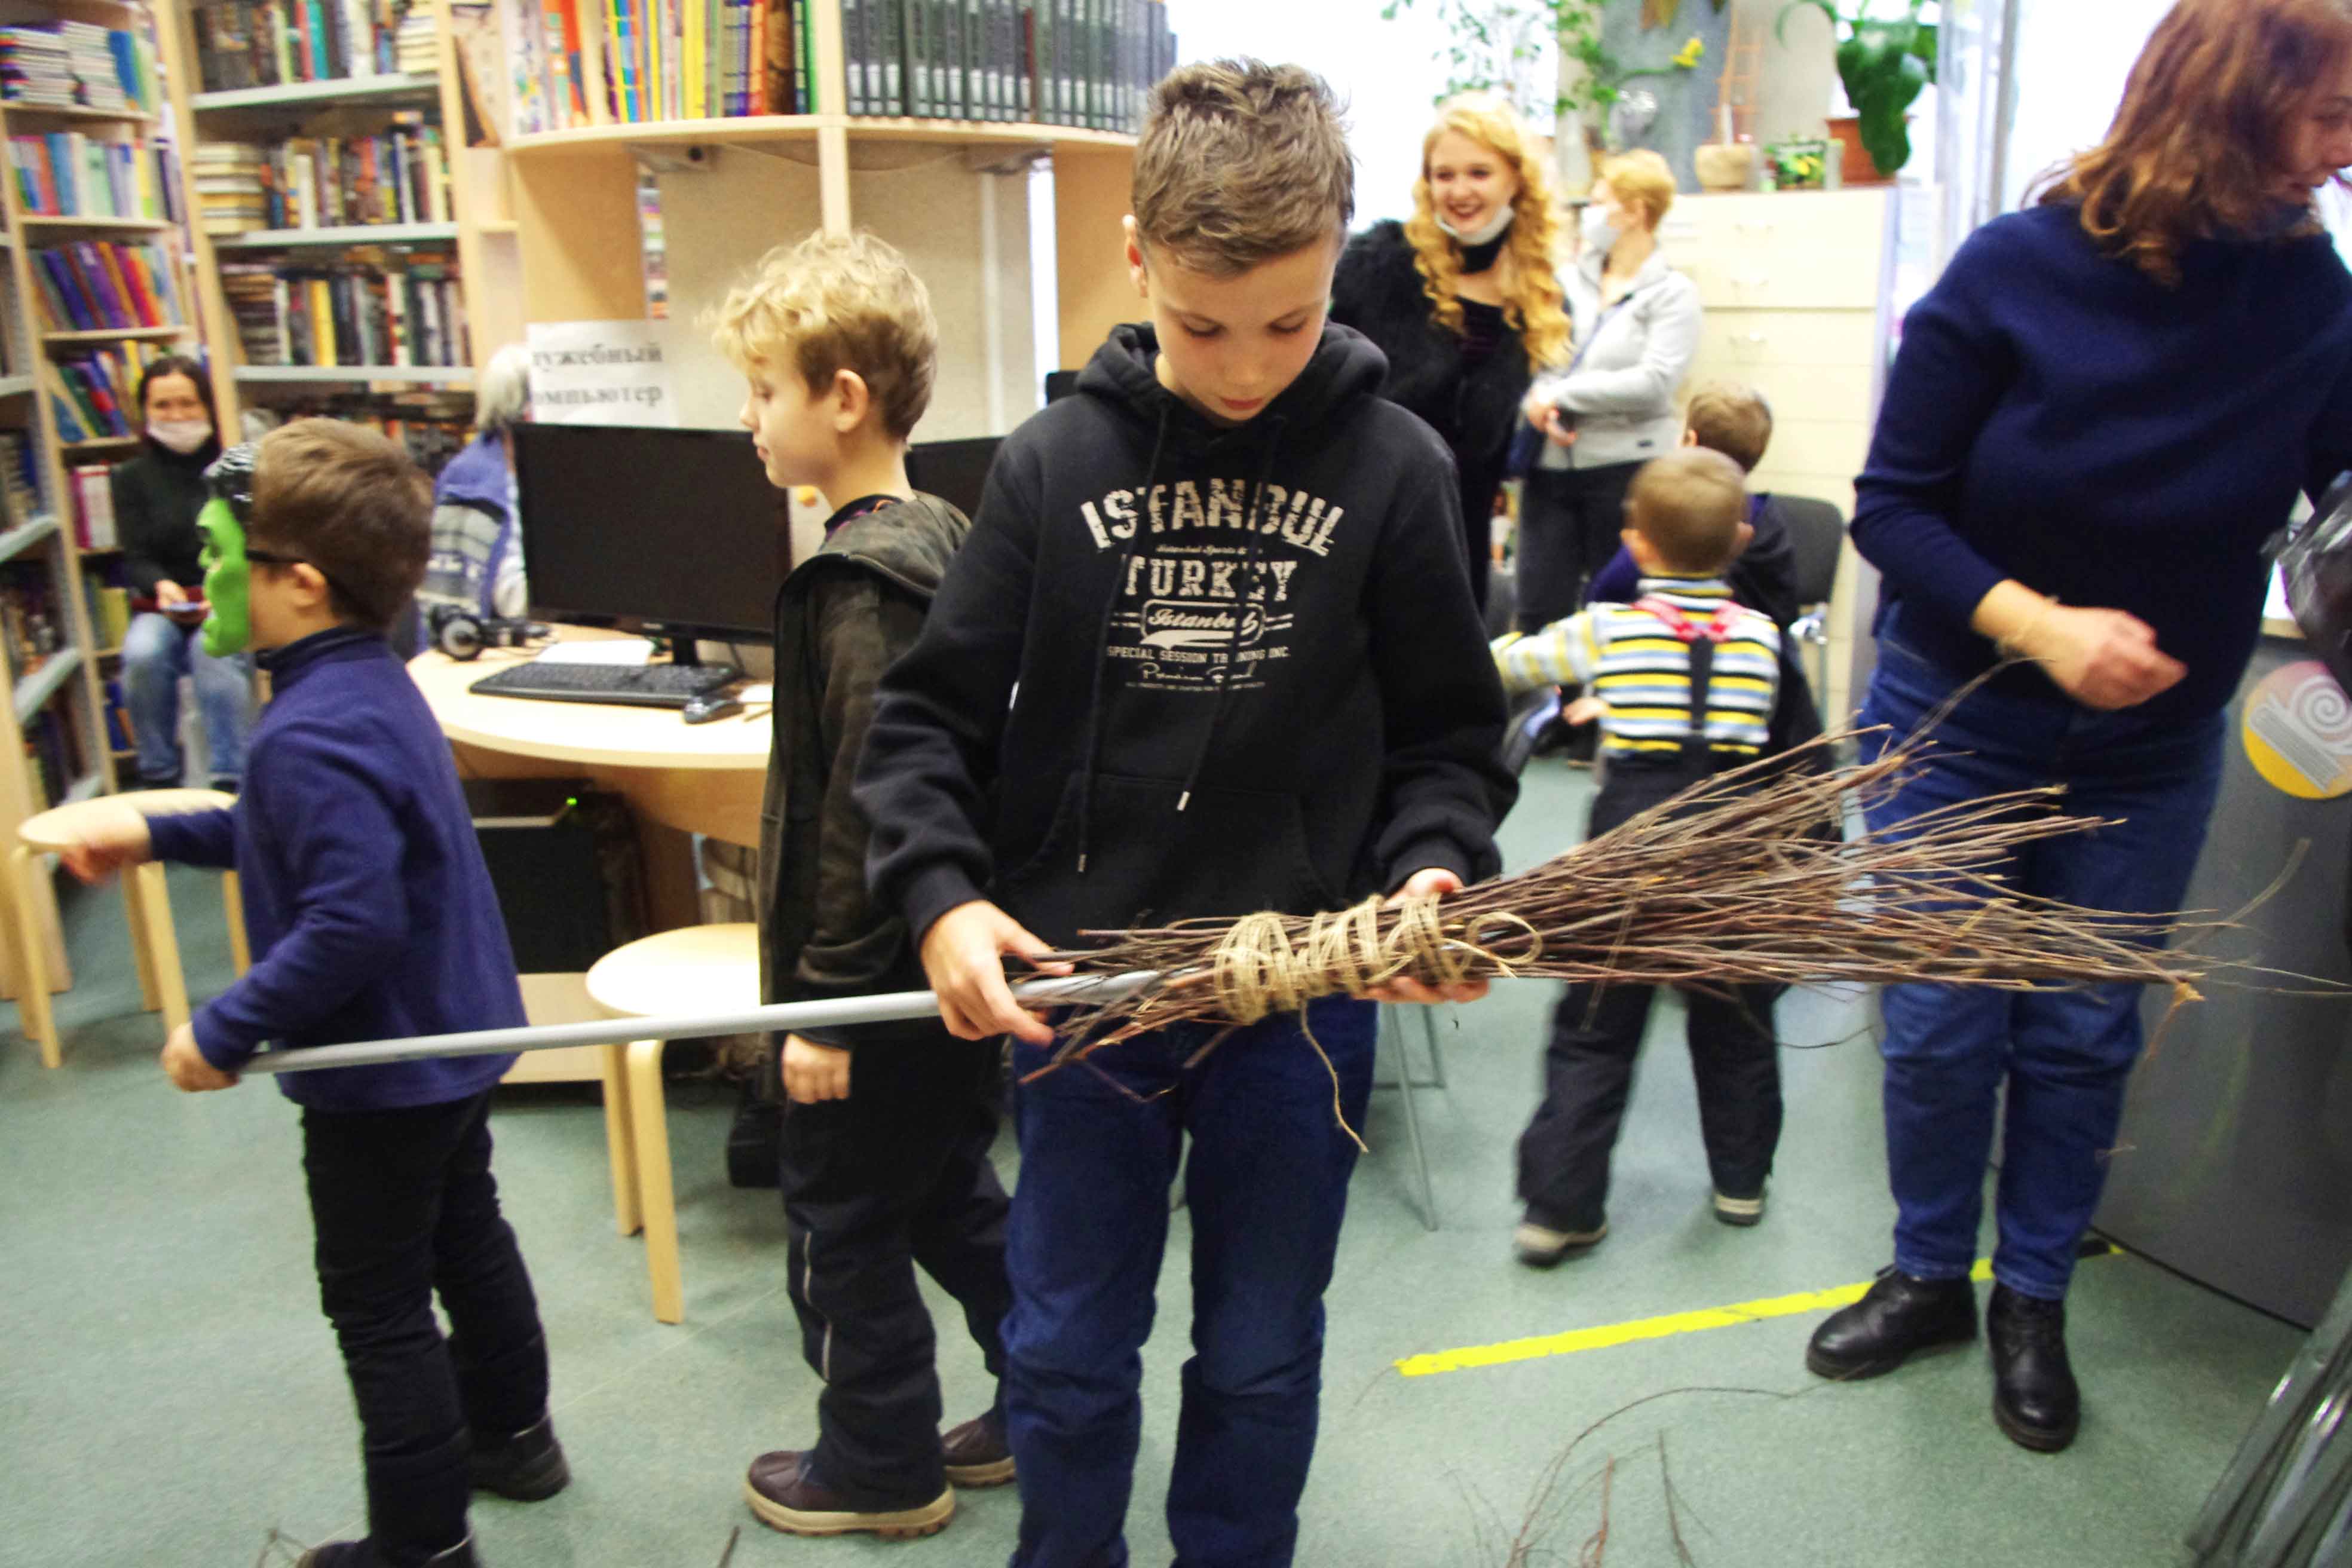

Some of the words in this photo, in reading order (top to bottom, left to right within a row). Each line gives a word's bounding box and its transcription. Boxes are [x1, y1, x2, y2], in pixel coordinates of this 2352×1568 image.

[1080, 478, 1344, 556] ISTANBUL
[1147, 608, 1259, 635] Istanbul
[1107, 645, 1154, 660] SPECIAL
[1159, 649, 1207, 663] SESSION
